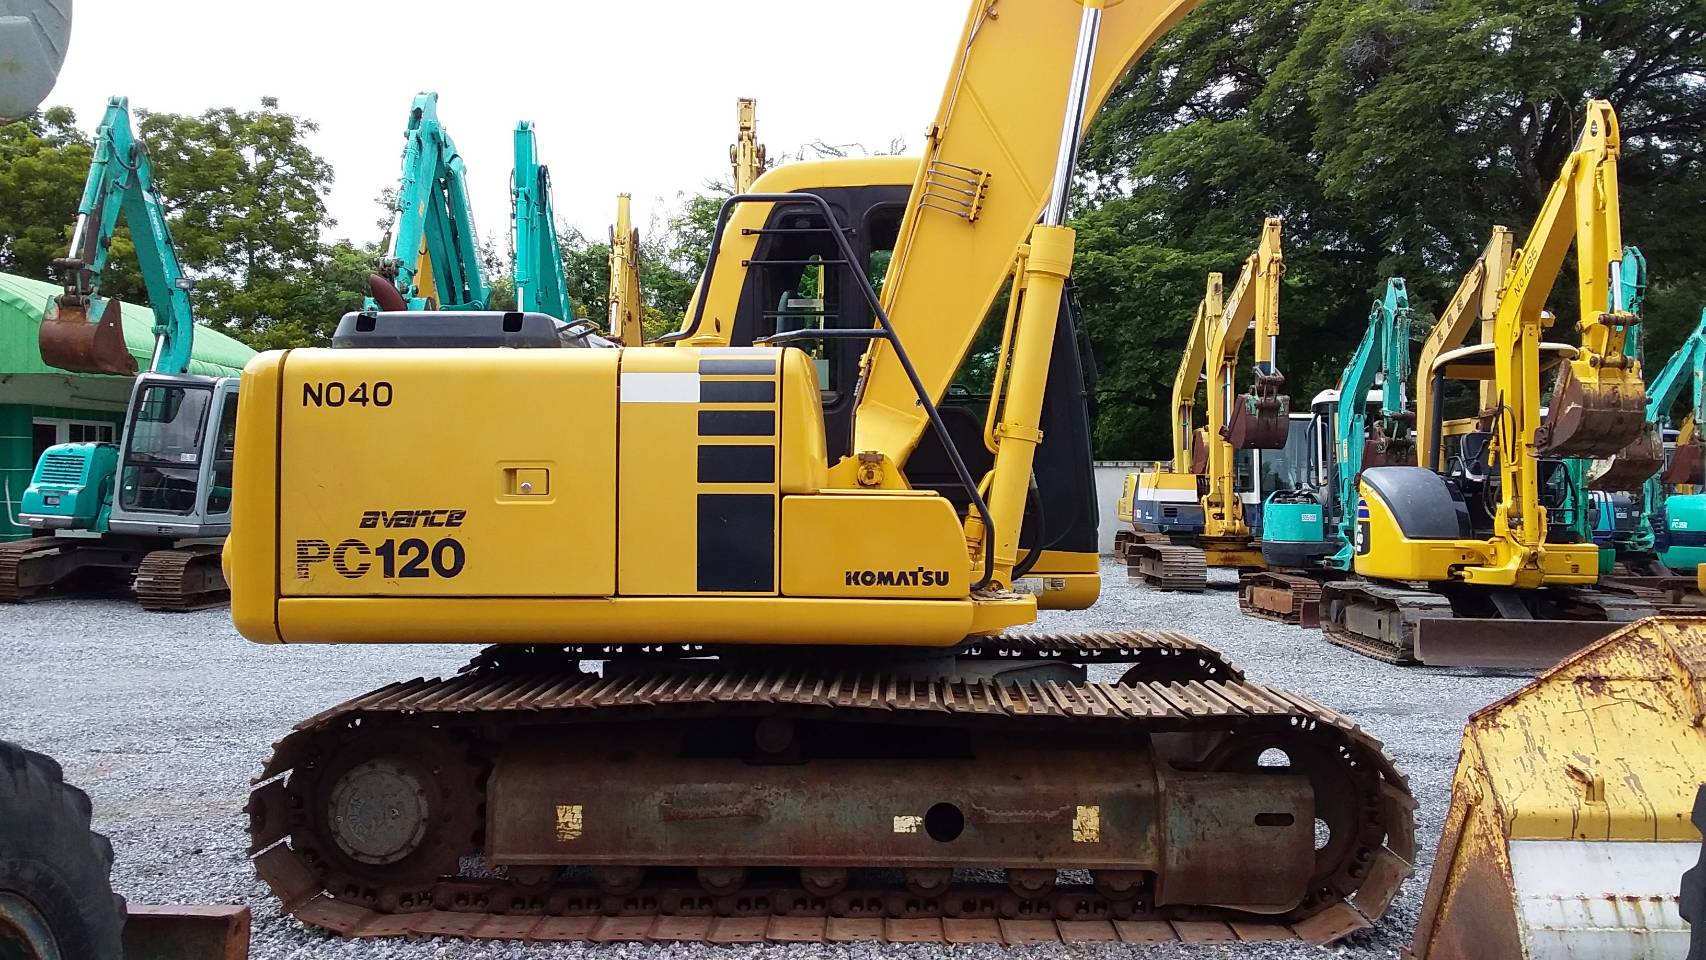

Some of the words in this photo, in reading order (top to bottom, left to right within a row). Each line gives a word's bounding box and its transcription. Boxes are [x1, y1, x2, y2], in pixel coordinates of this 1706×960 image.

[359, 509, 467, 529] avance
[296, 537, 466, 579] PC120
[845, 566, 949, 586] KOMATSU
